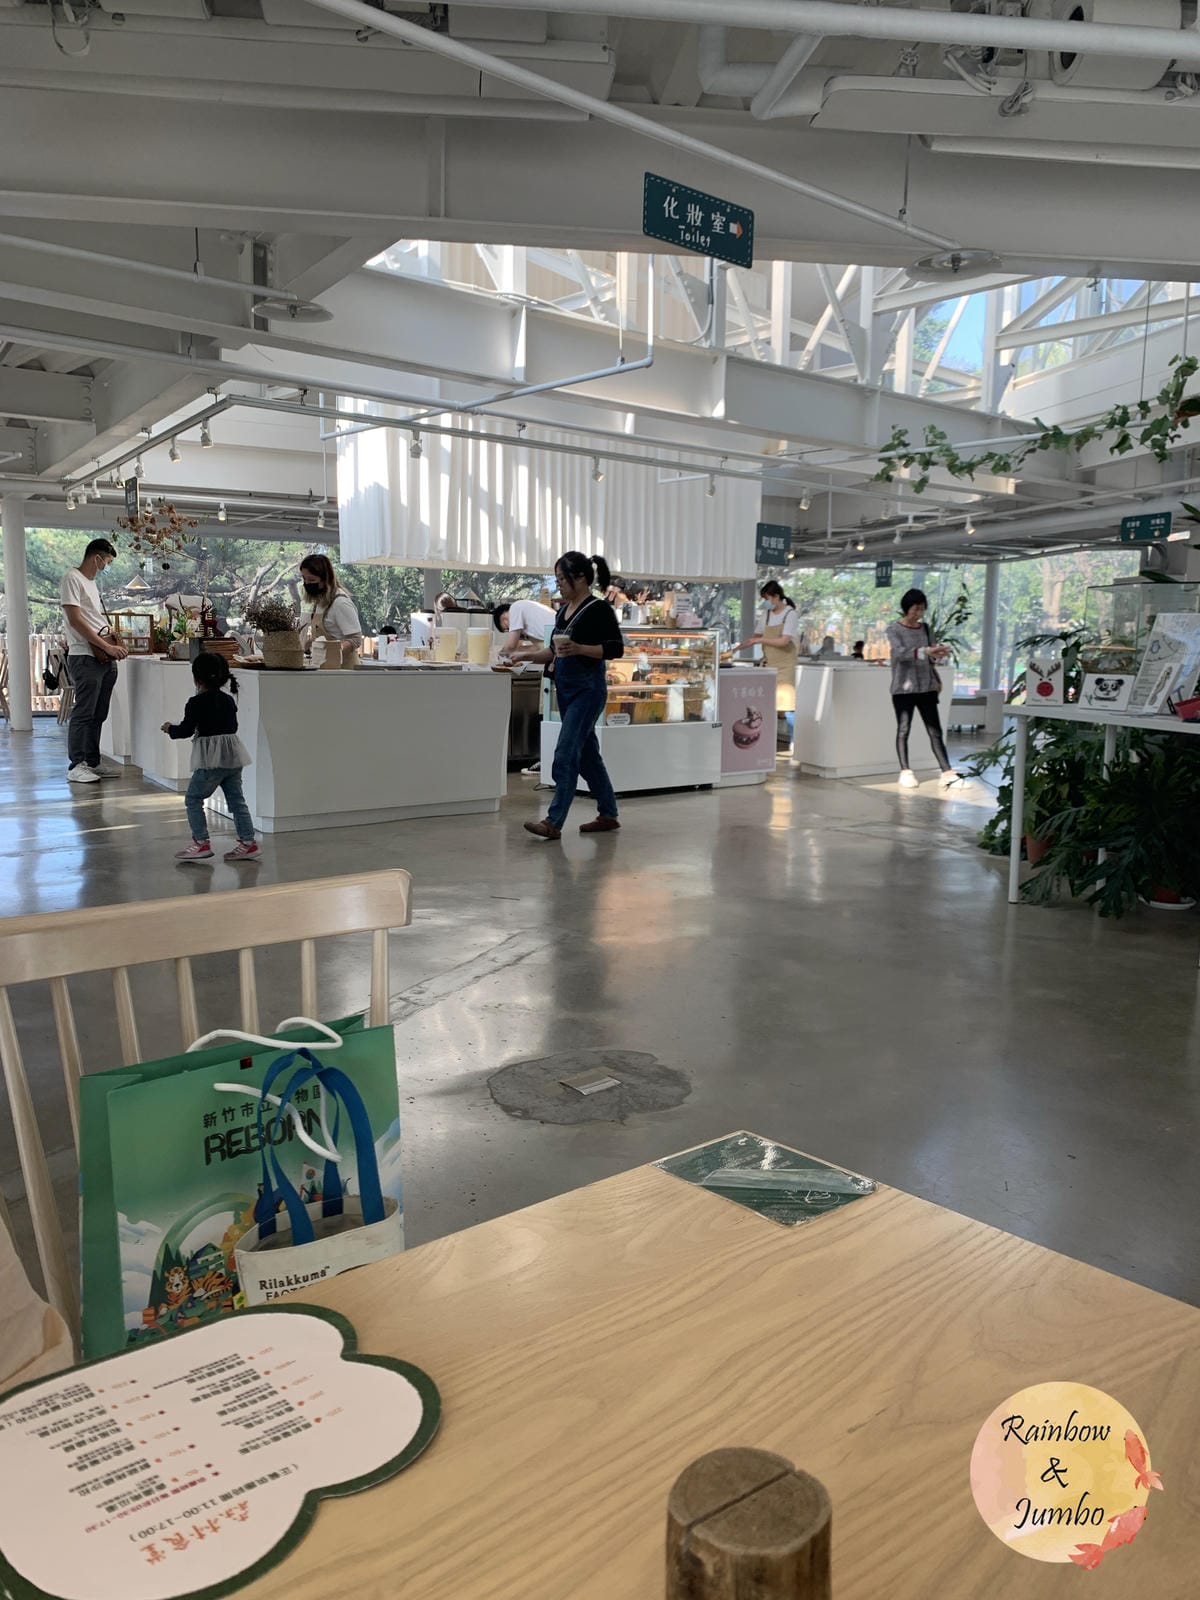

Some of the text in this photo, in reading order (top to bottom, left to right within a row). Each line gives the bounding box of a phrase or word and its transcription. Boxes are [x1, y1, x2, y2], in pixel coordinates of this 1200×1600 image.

[663, 195, 727, 235] 化妝室
[678, 224, 711, 248] Toilet
[139, 1501, 249, 1564] 森林食堂
